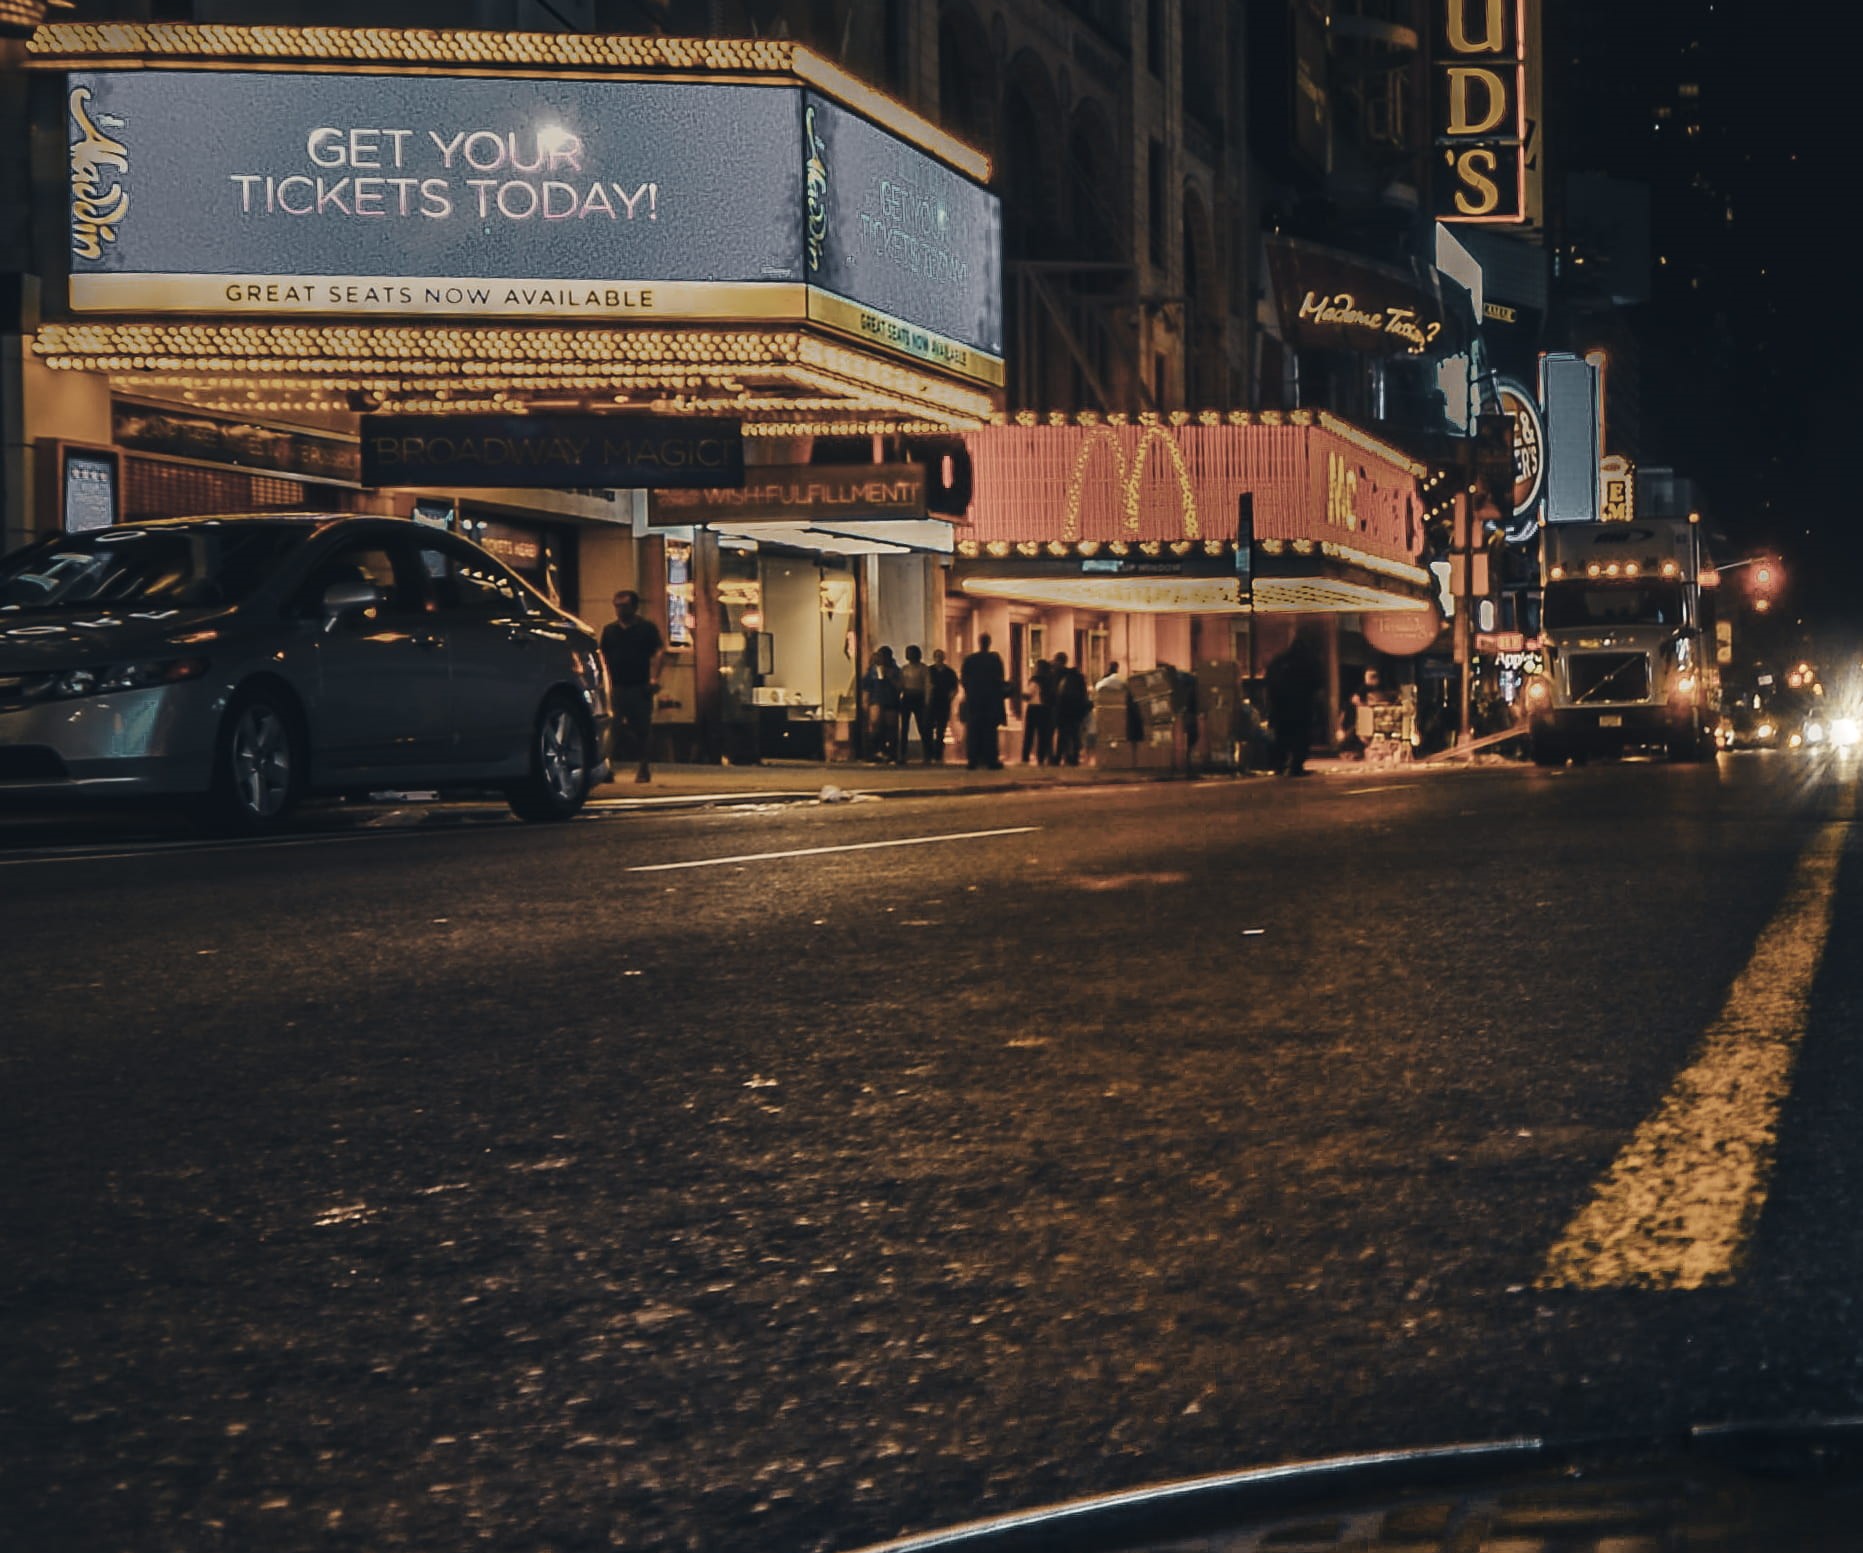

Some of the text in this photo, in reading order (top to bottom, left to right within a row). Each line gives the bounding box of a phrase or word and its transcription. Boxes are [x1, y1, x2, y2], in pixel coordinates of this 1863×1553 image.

[307, 127, 583, 172] GET YOUR
[230, 174, 660, 221] TICKETS TODAY!
[225, 284, 653, 308] GREAT SEATS NOW AVAILABLE
